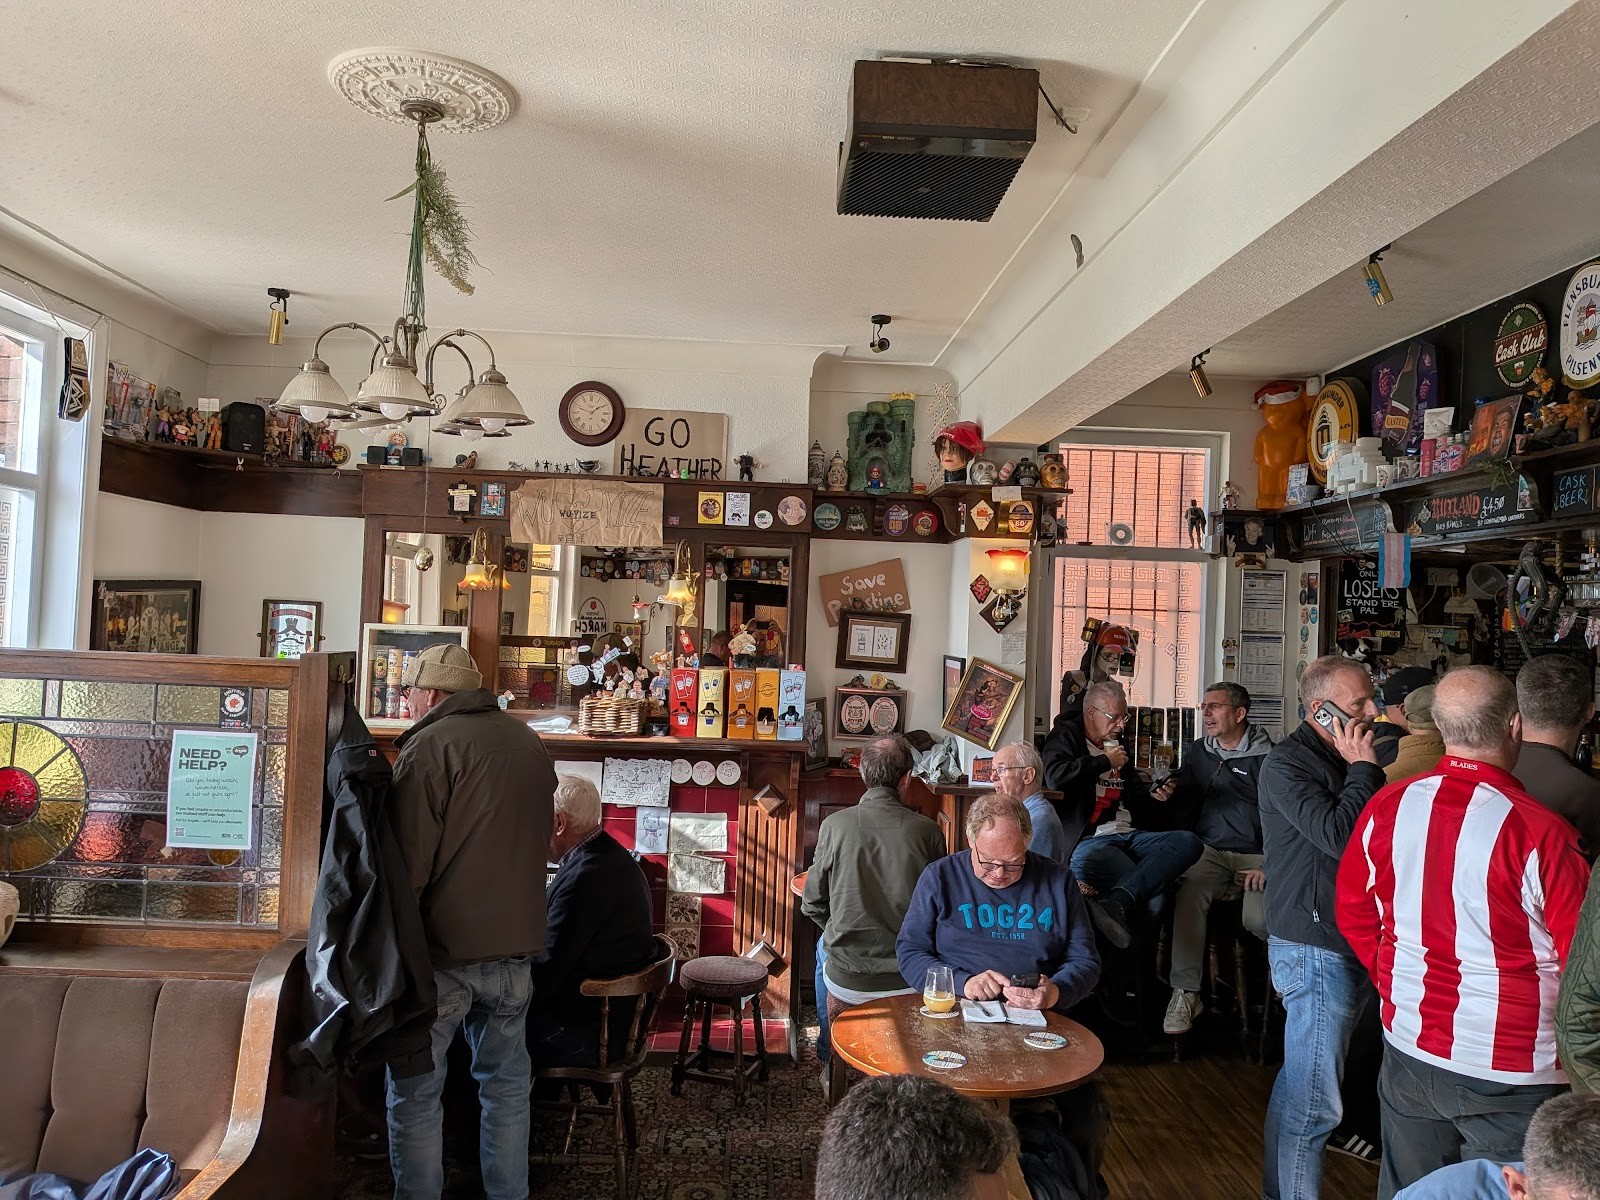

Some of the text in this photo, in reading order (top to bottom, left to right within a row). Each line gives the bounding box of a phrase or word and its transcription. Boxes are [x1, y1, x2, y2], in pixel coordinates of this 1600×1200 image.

[1564, 274, 1600, 327] FLENSBU
[1495, 329, 1546, 363] Cask Club
[644, 416, 691, 449] GO
[619, 443, 723, 481] HEATHER
[1559, 474, 1587, 491] CASK
[1559, 488, 1585, 508] BEER
[840, 573, 886, 595] Save
[1345, 599, 1379, 607] STAND
[1360, 607, 1378, 615] PAL
[179, 748, 222, 760] NEED
[178, 759, 228, 772] HELP?
[1450, 760, 1478, 770] BLADES
[957, 902, 1054, 933] TOG24
